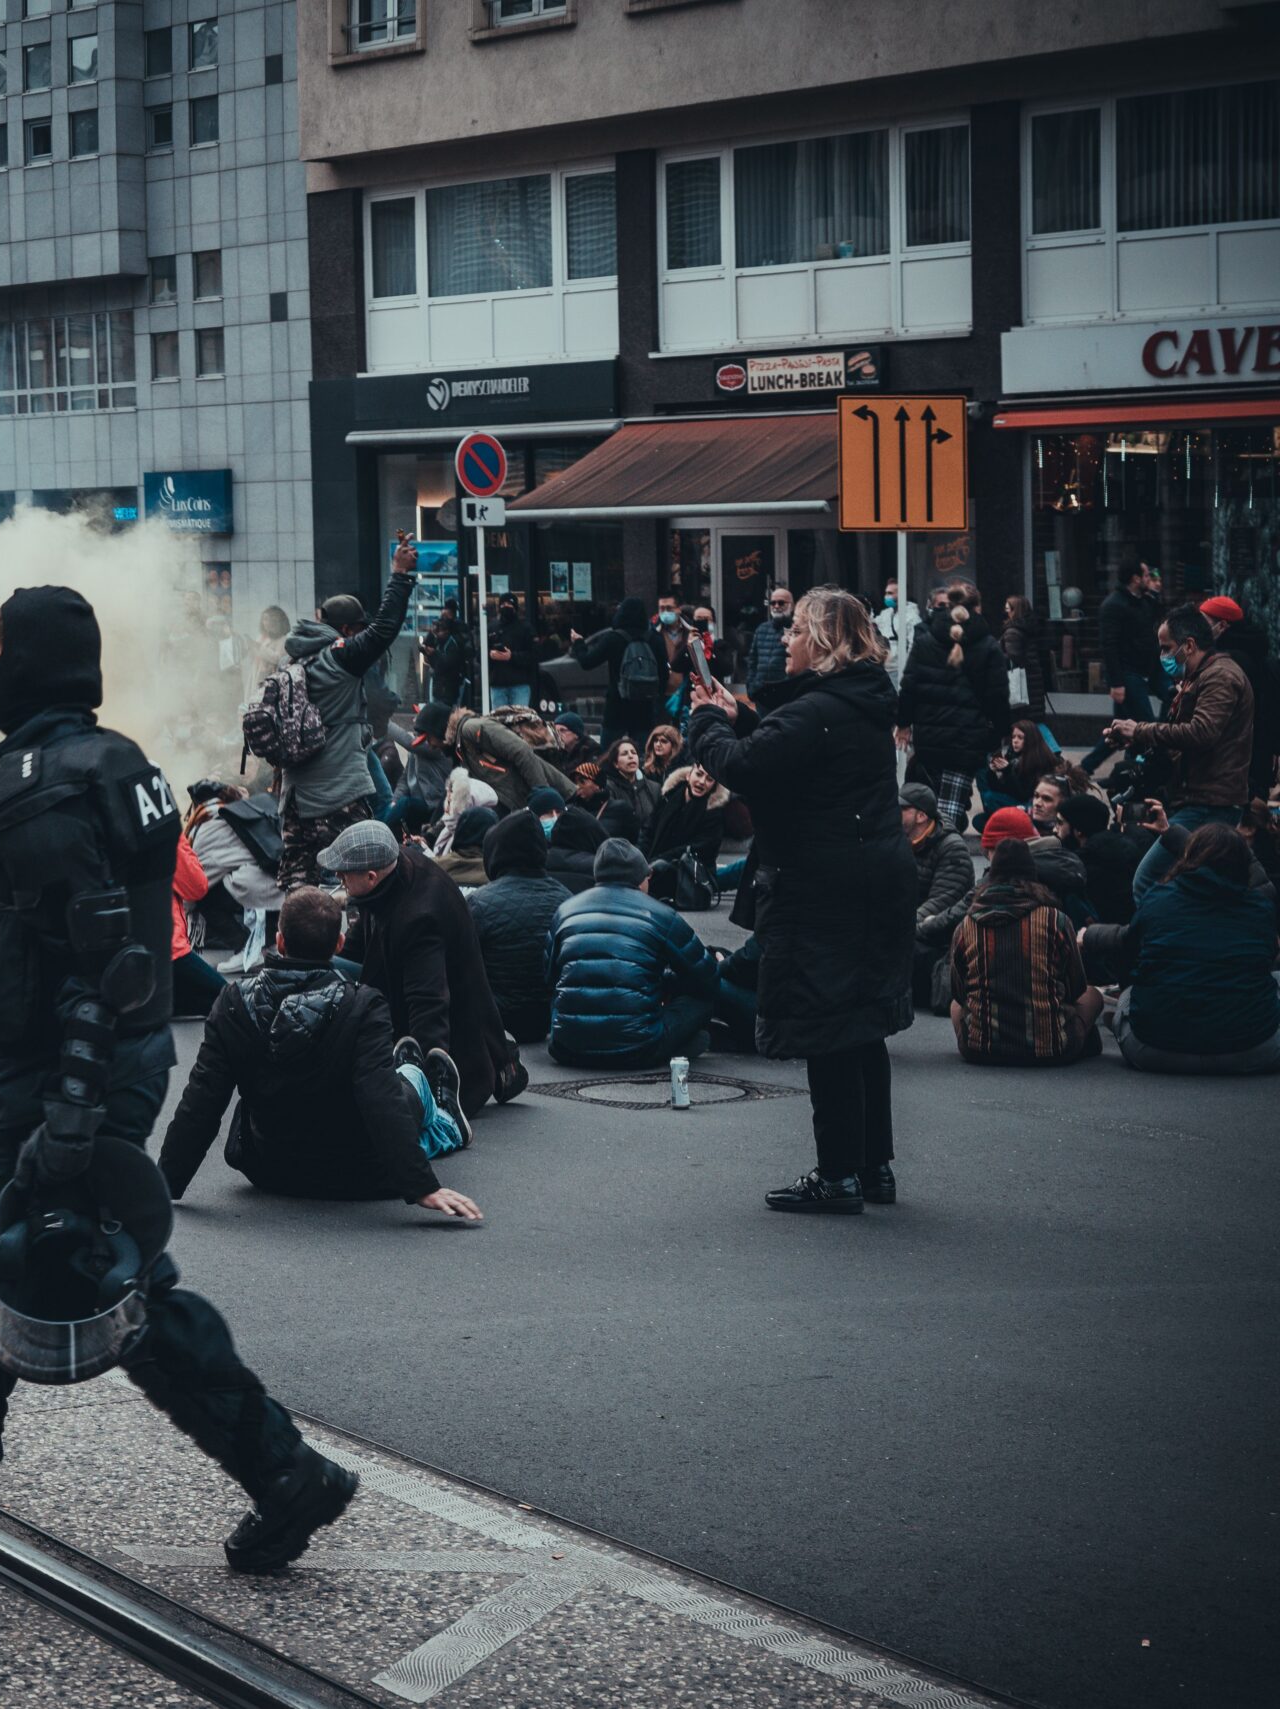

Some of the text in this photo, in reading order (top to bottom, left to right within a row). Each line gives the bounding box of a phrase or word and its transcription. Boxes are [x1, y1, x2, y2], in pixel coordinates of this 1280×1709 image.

[1142, 325, 1280, 378] CAVE
[750, 371, 843, 392] LUNCH-BREAK
[135, 783, 162, 827] A
